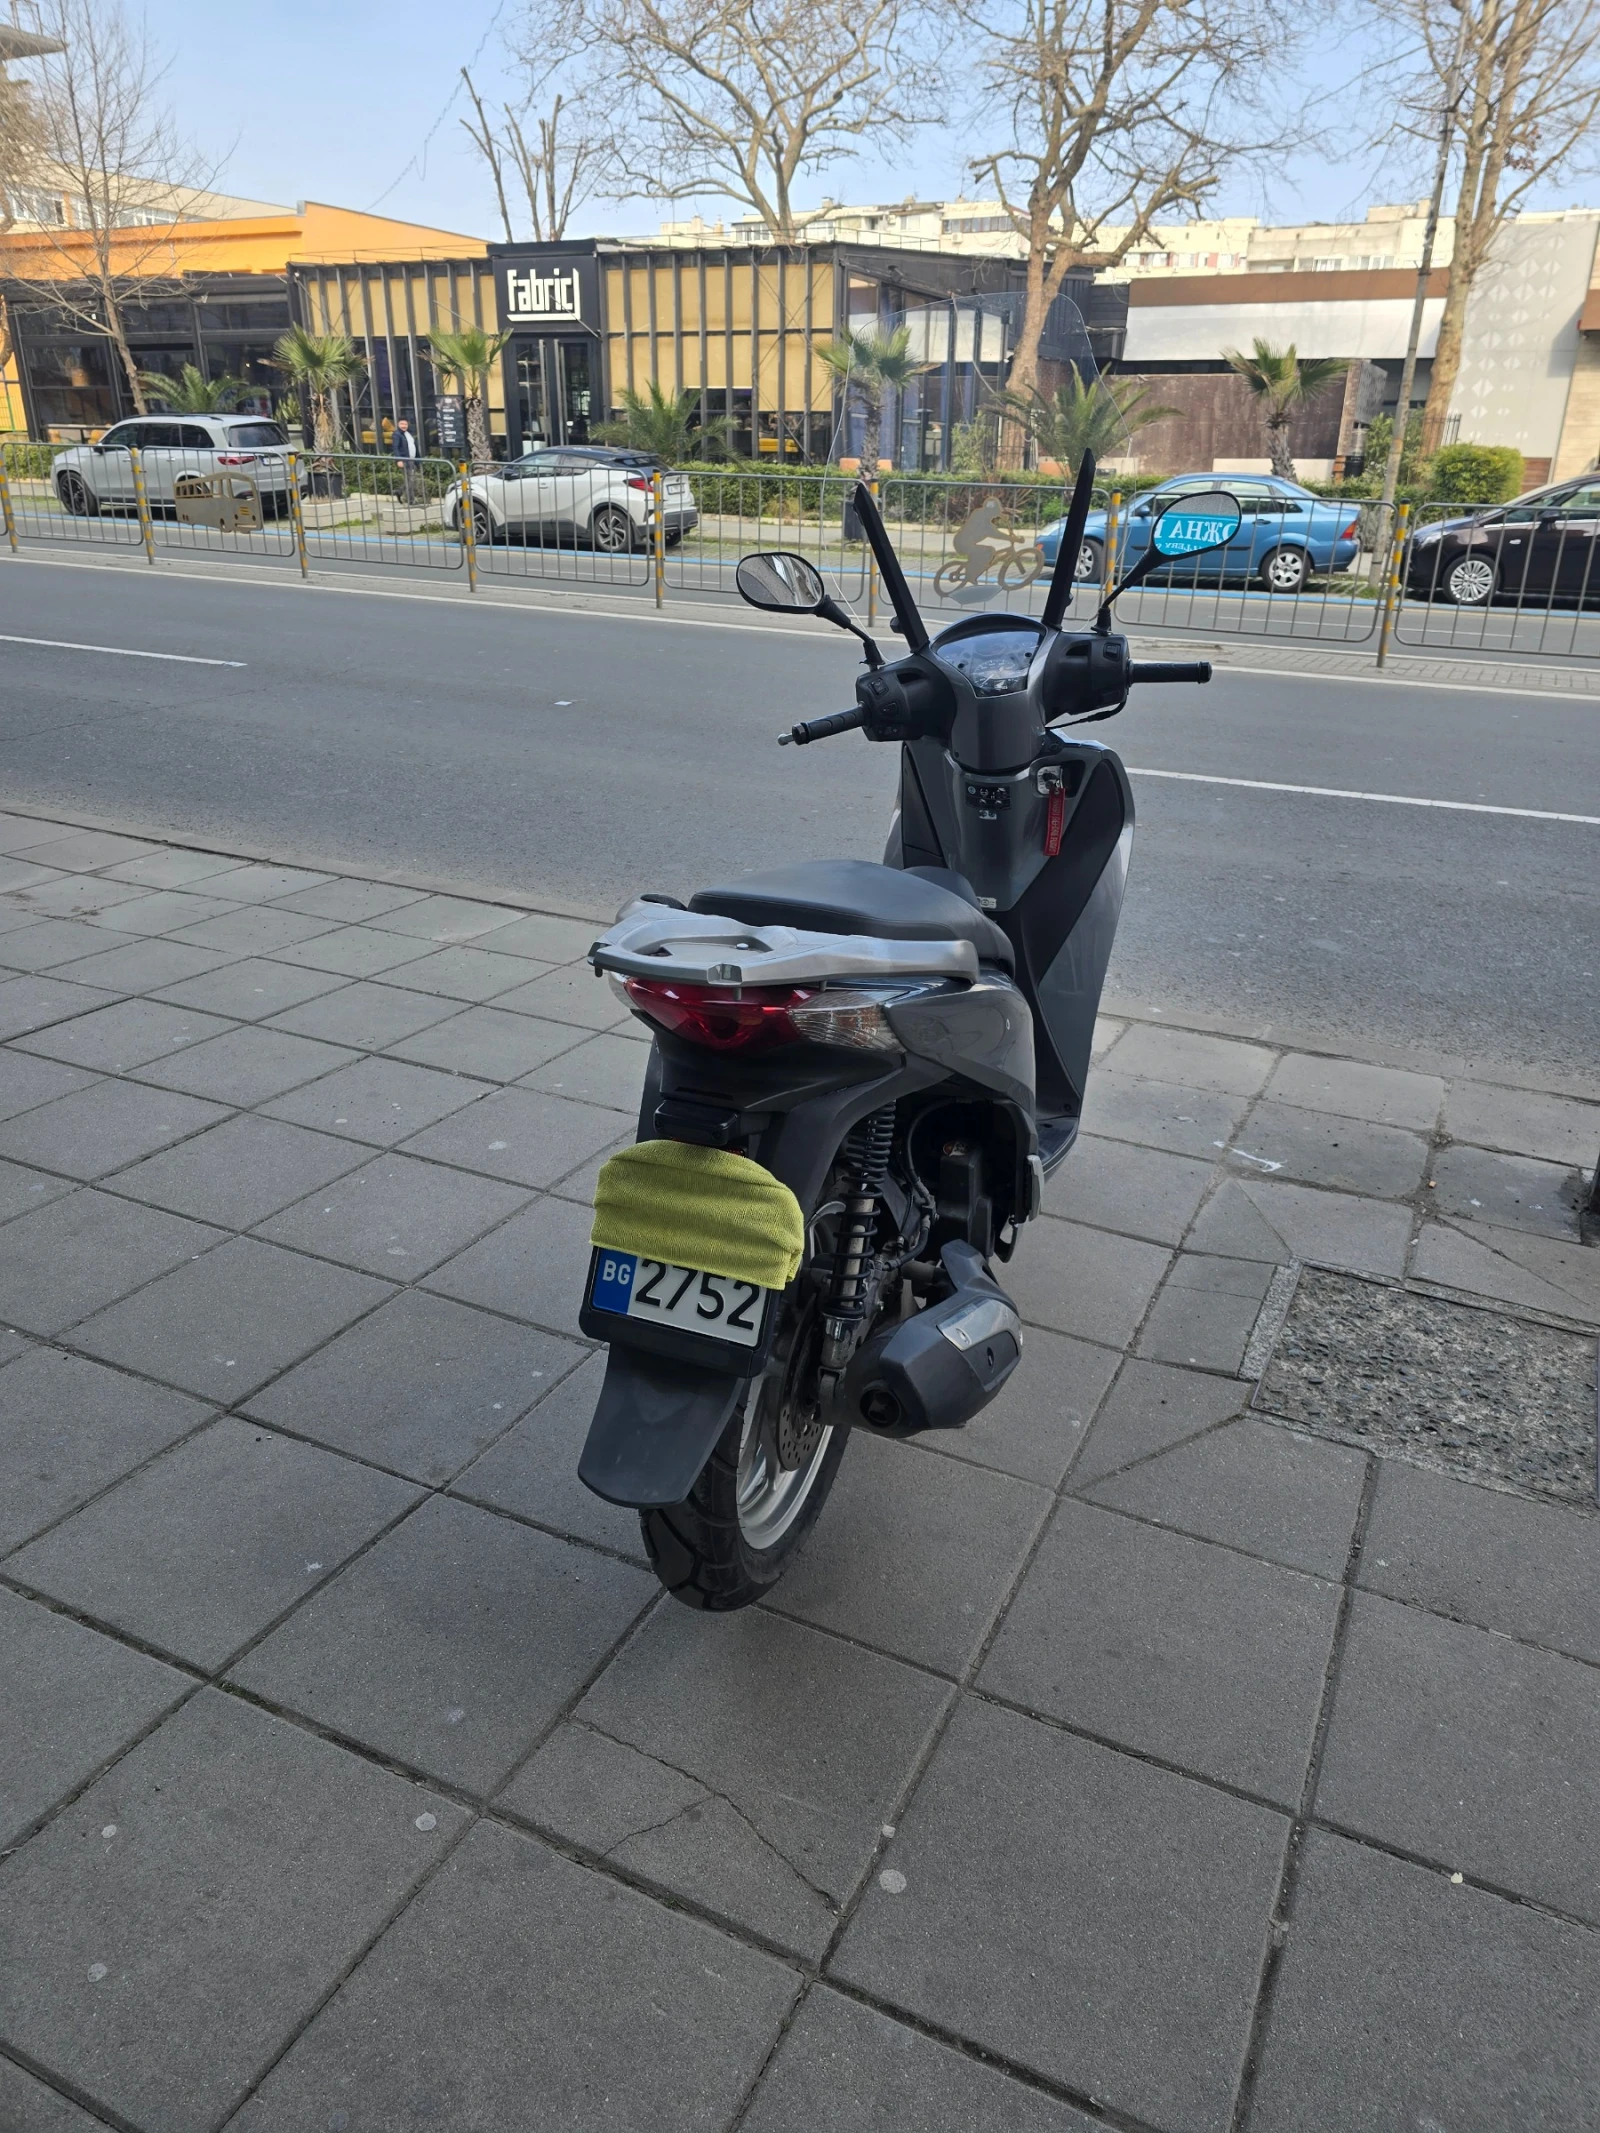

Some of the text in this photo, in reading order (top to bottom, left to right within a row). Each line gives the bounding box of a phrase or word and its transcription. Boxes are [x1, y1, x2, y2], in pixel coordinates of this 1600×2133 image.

[507, 268, 573, 311] fabric
[602, 1258, 760, 1331] BG 2752
